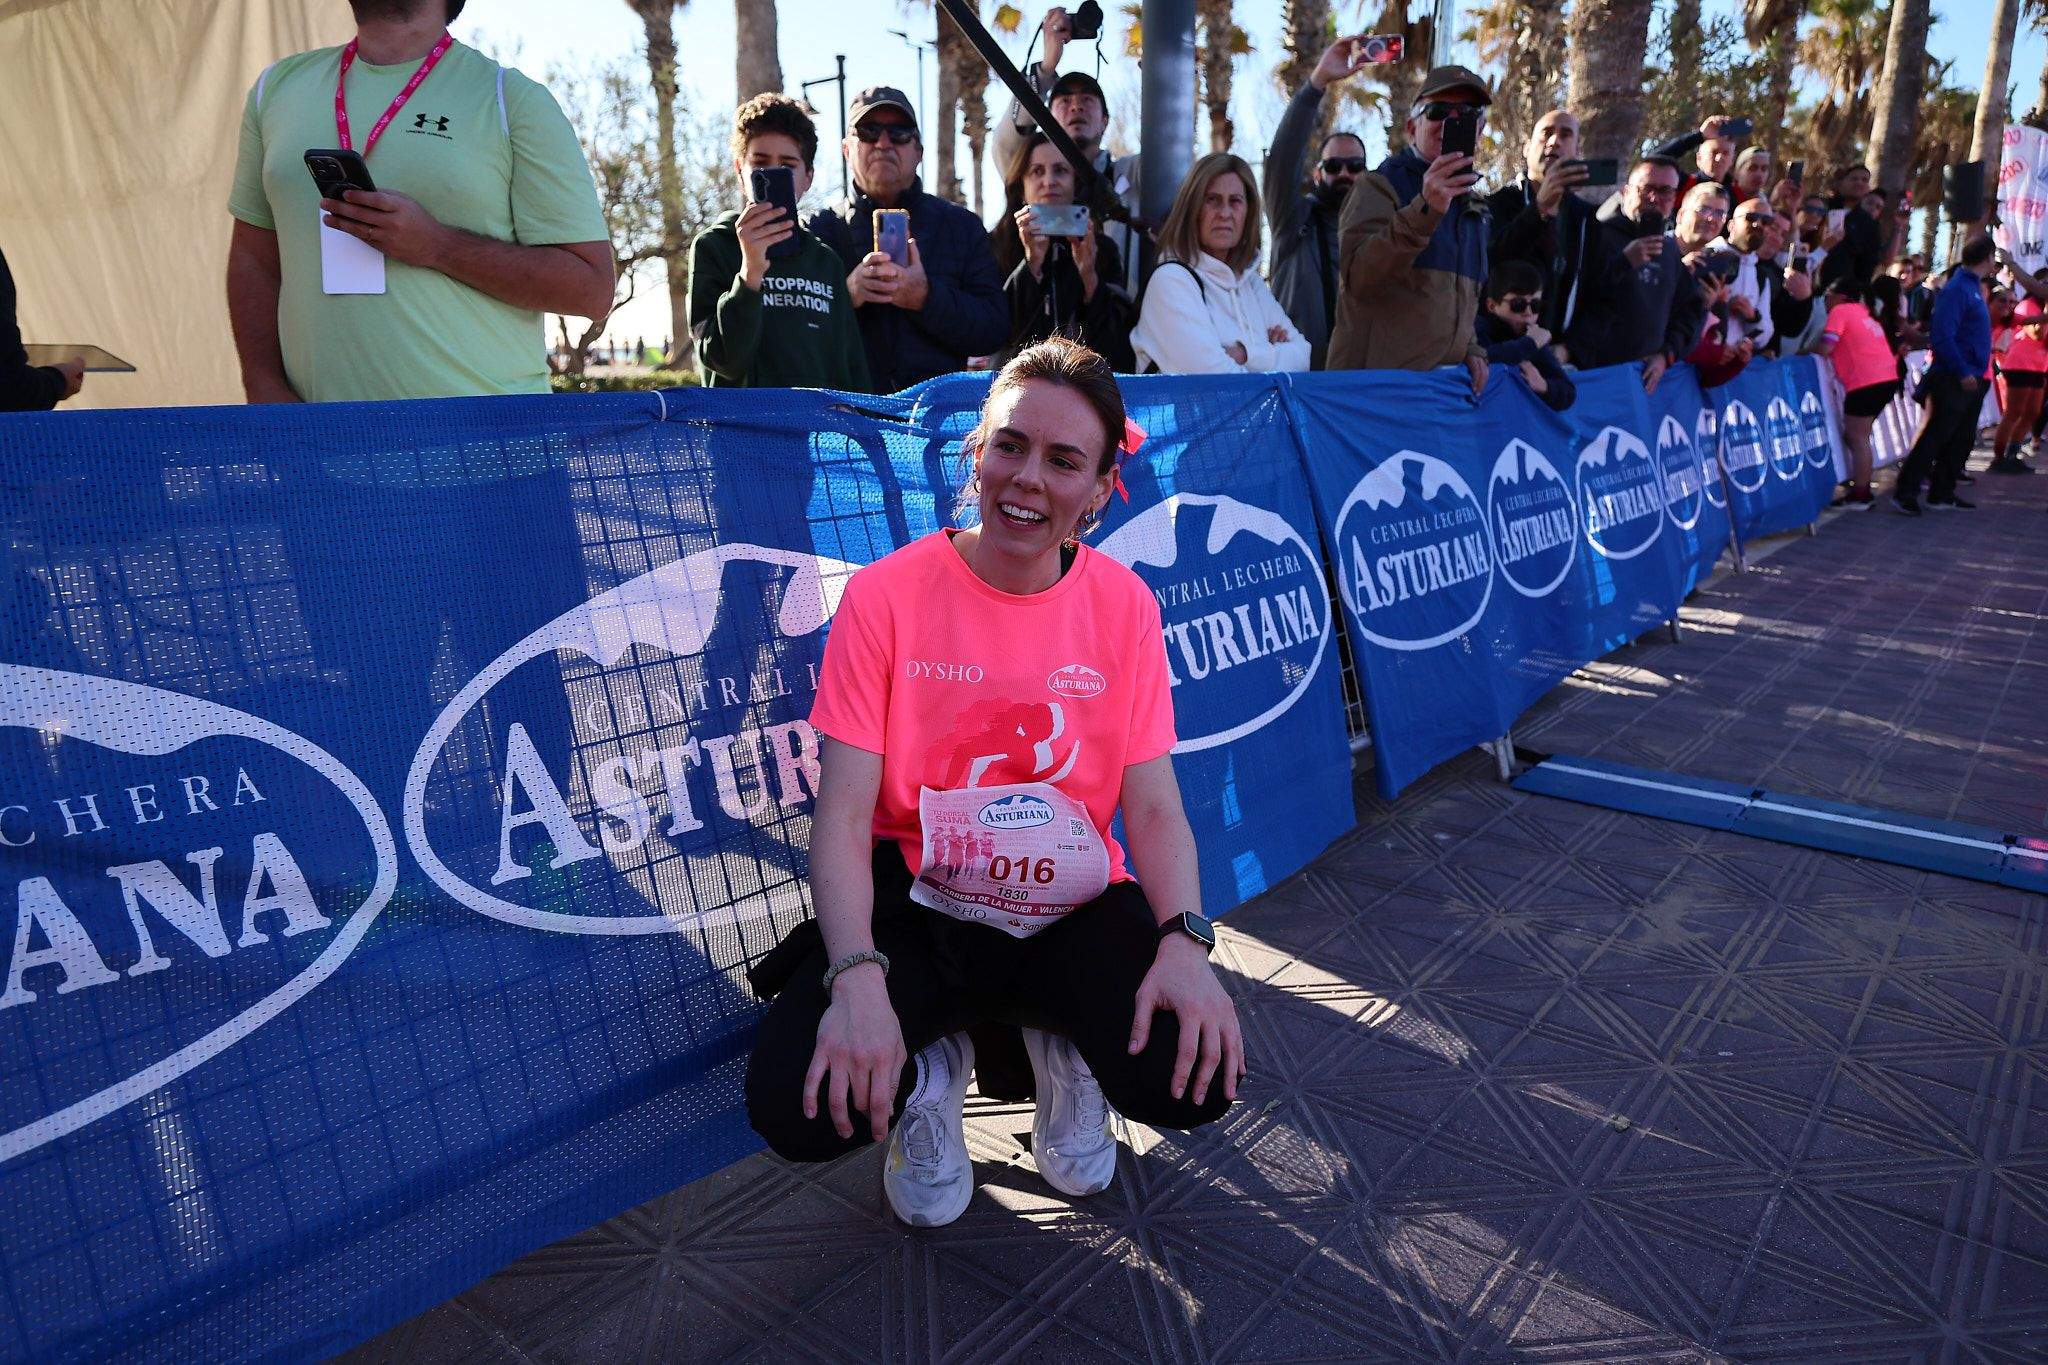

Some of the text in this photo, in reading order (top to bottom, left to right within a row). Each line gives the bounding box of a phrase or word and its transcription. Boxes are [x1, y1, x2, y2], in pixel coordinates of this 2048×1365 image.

[763, 293, 830, 313] NERATION
[1371, 516, 1430, 545] CENTRAL
[1496, 502, 1573, 565] ASTURIANA
[1221, 553, 1301, 591] LECHERA
[1352, 531, 1490, 615] ASTURIANA
[906, 660, 984, 683] OYSHO
[1053, 675, 1101, 691] ASTURIANA
[587, 667, 792, 732] CENTRAL
[936, 815, 972, 826] SUMA
[984, 809, 1051, 823] ASTURIANA
[988, 855, 1056, 884] 016
[932, 893, 987, 920] OYSHO
[939, 885, 976, 902] CARRERA
[978, 896, 990, 904] DE
[991, 898, 1002, 907] LA
[1003, 902, 1033, 914] MUJER
[996, 886, 1029, 901] 1830
